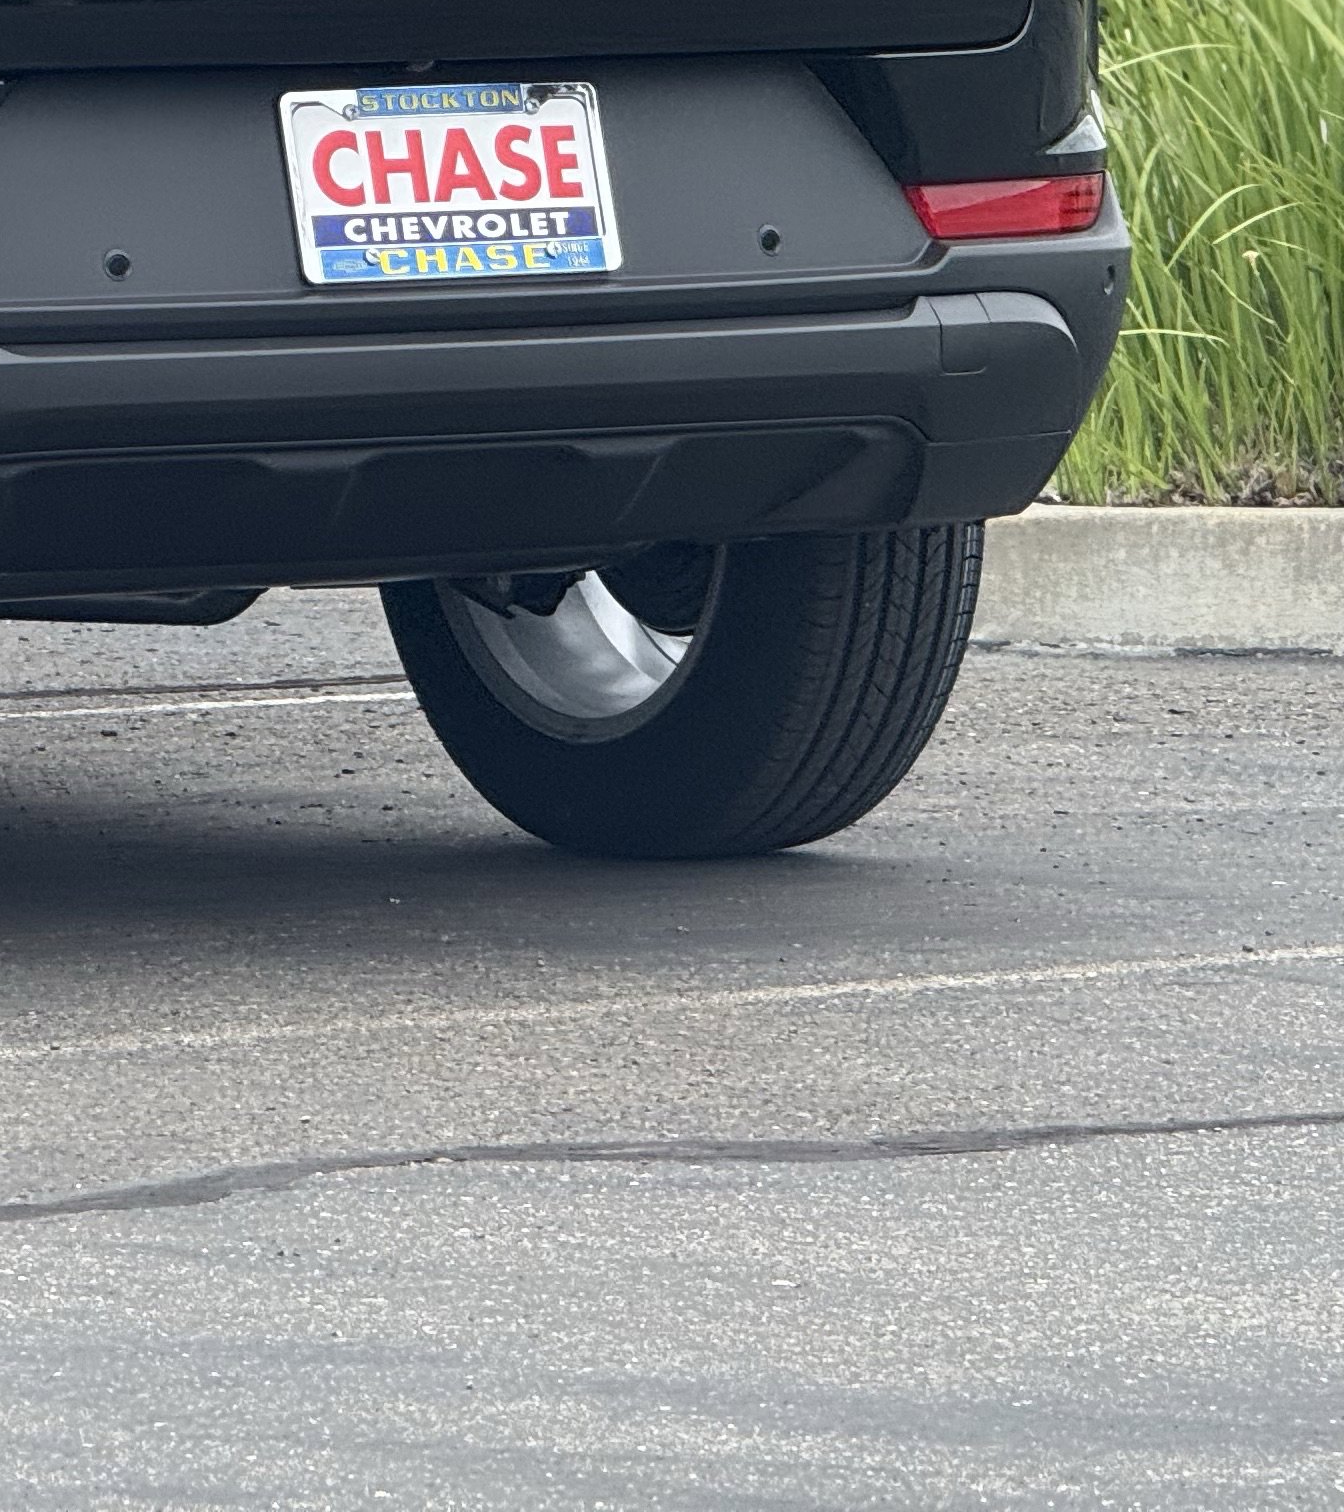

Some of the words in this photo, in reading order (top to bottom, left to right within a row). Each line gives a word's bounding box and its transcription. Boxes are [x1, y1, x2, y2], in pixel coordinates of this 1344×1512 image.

[362, 89, 520, 111] STOCKTON
[313, 125, 583, 206] CHASE
[344, 213, 569, 242] CHEVROLET
[379, 243, 551, 274] CHASE
